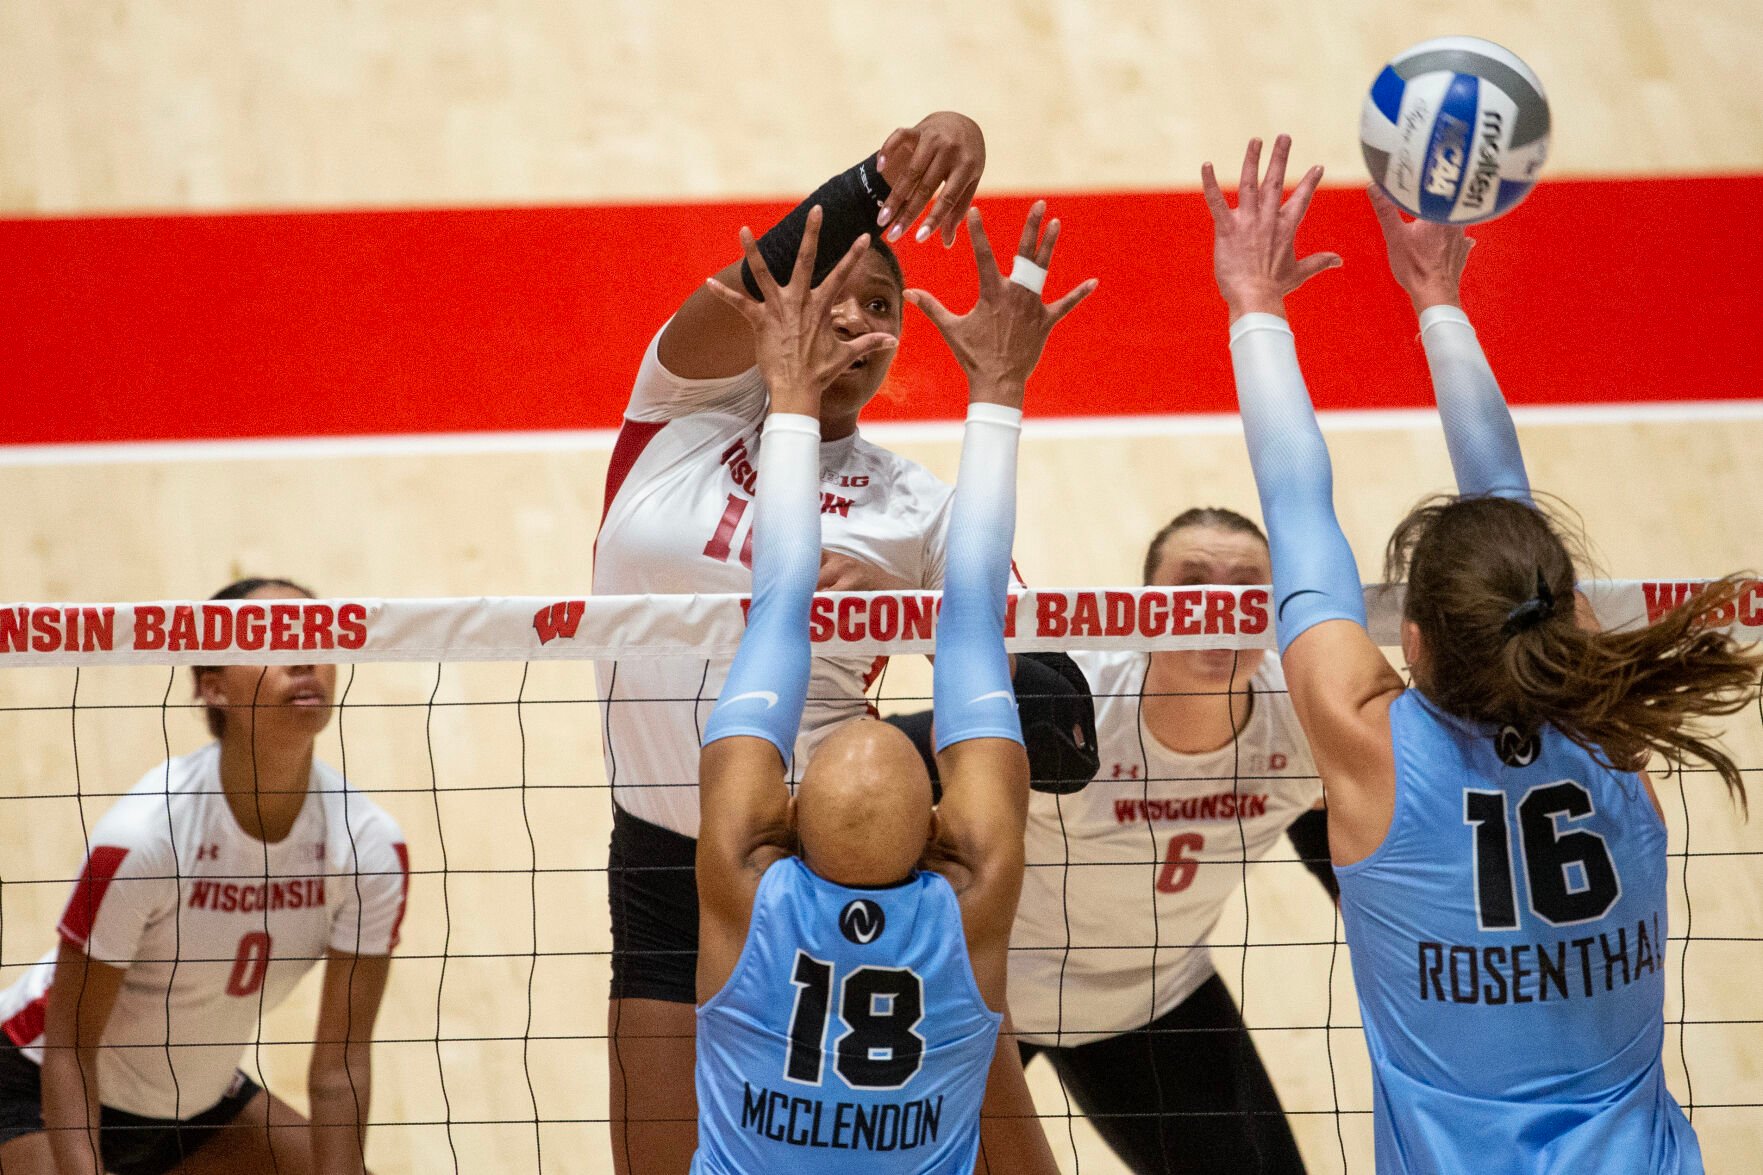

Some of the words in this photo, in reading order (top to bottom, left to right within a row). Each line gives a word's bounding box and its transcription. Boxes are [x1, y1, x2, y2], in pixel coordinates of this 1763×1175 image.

[1462, 110, 1502, 208] molten
[133, 603, 367, 651] BADGERS
[1036, 589, 1269, 638] BADGERS
[1113, 790, 1269, 826] WISCONSIN
[1155, 831, 1206, 895] 6
[1462, 779, 1622, 932] 16
[187, 877, 326, 914] WISCONSIN
[225, 931, 273, 998] 0
[783, 948, 926, 1092] 18
[740, 1080, 944, 1151] MCCLENDON
